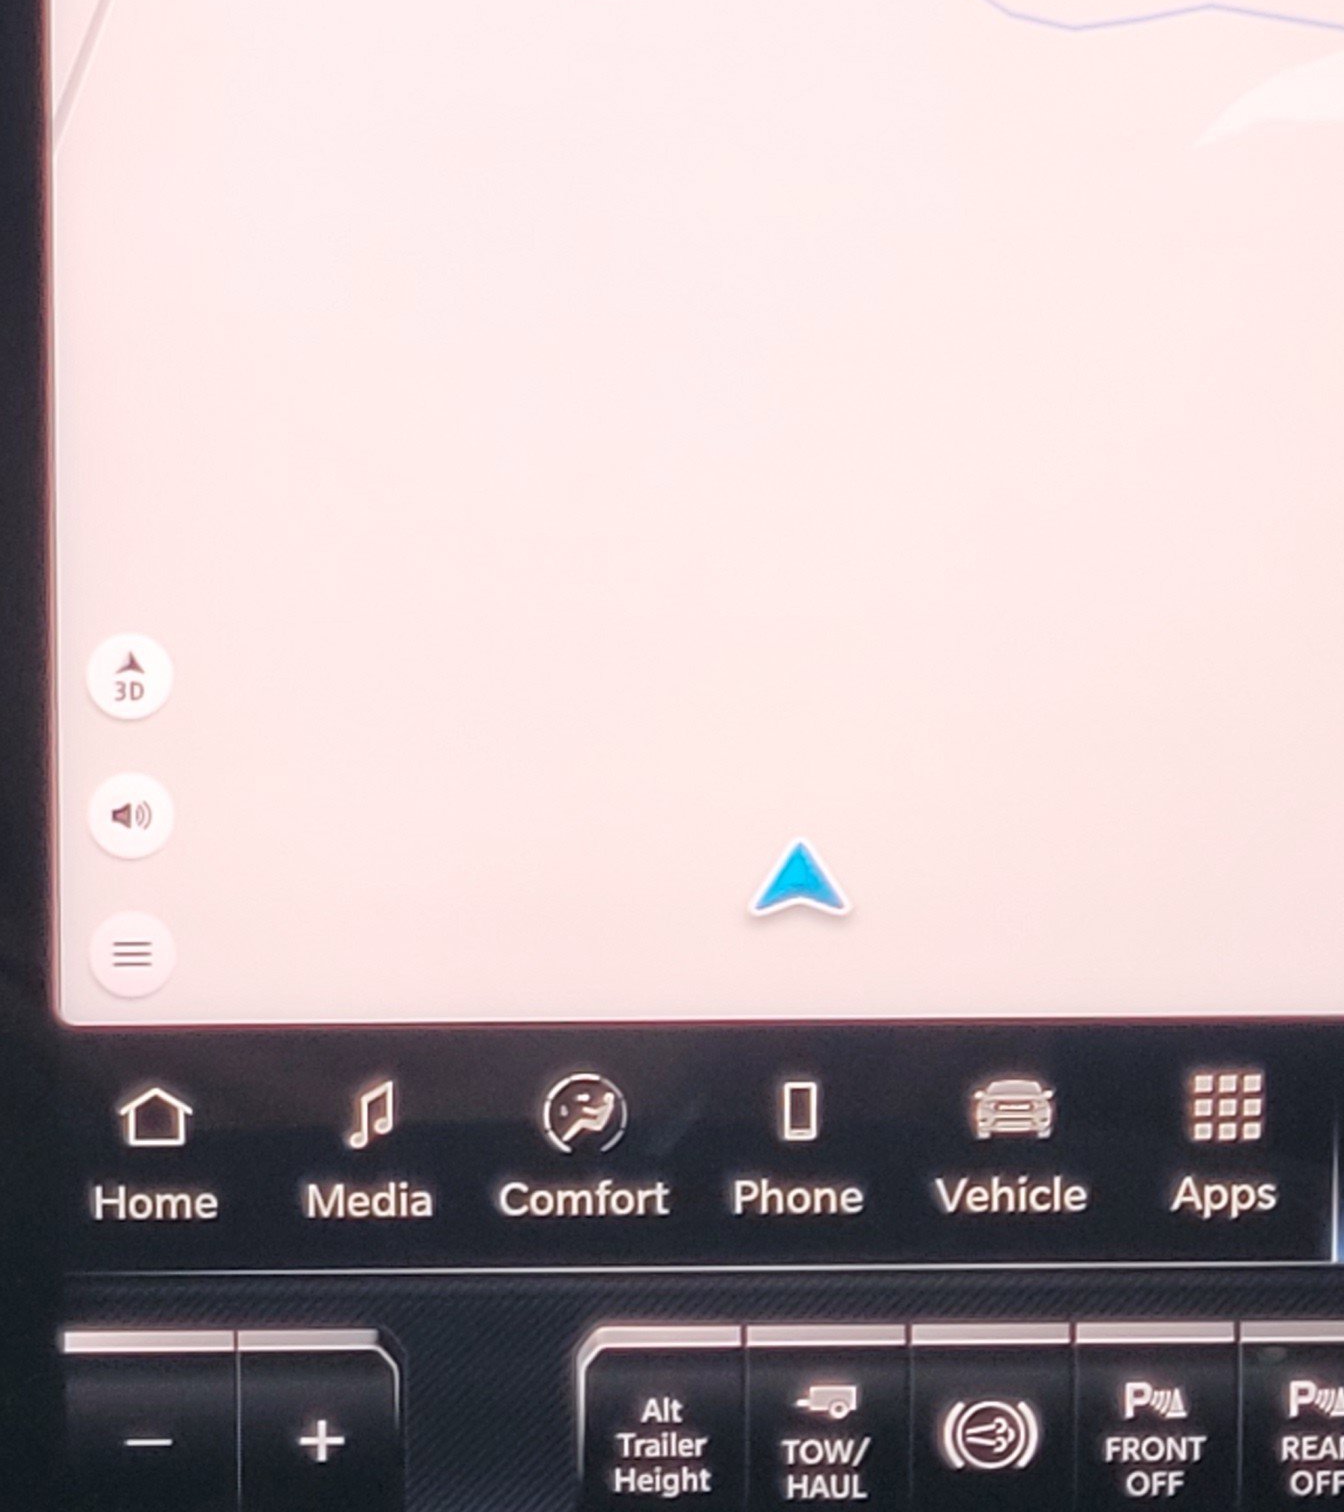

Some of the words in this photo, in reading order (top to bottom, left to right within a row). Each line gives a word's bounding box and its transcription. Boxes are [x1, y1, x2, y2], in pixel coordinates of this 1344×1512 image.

[114, 681, 145, 702] 3D
[93, 1184, 219, 1220] Home
[306, 1182, 434, 1218] Media
[498, 1179, 670, 1218] Comfort
[733, 1179, 865, 1215] Phone
[935, 1176, 1088, 1213] Vehicle
[1170, 1176, 1277, 1218] Apps
[641, 1397, 683, 1424] Alt
[614, 1431, 708, 1459] Trailer
[782, 1436, 871, 1468] TOW/
[1105, 1435, 1206, 1462] FRONT
[613, 1466, 711, 1498] Height
[786, 1471, 868, 1500] HAUL
[1125, 1470, 1185, 1497] OFF
